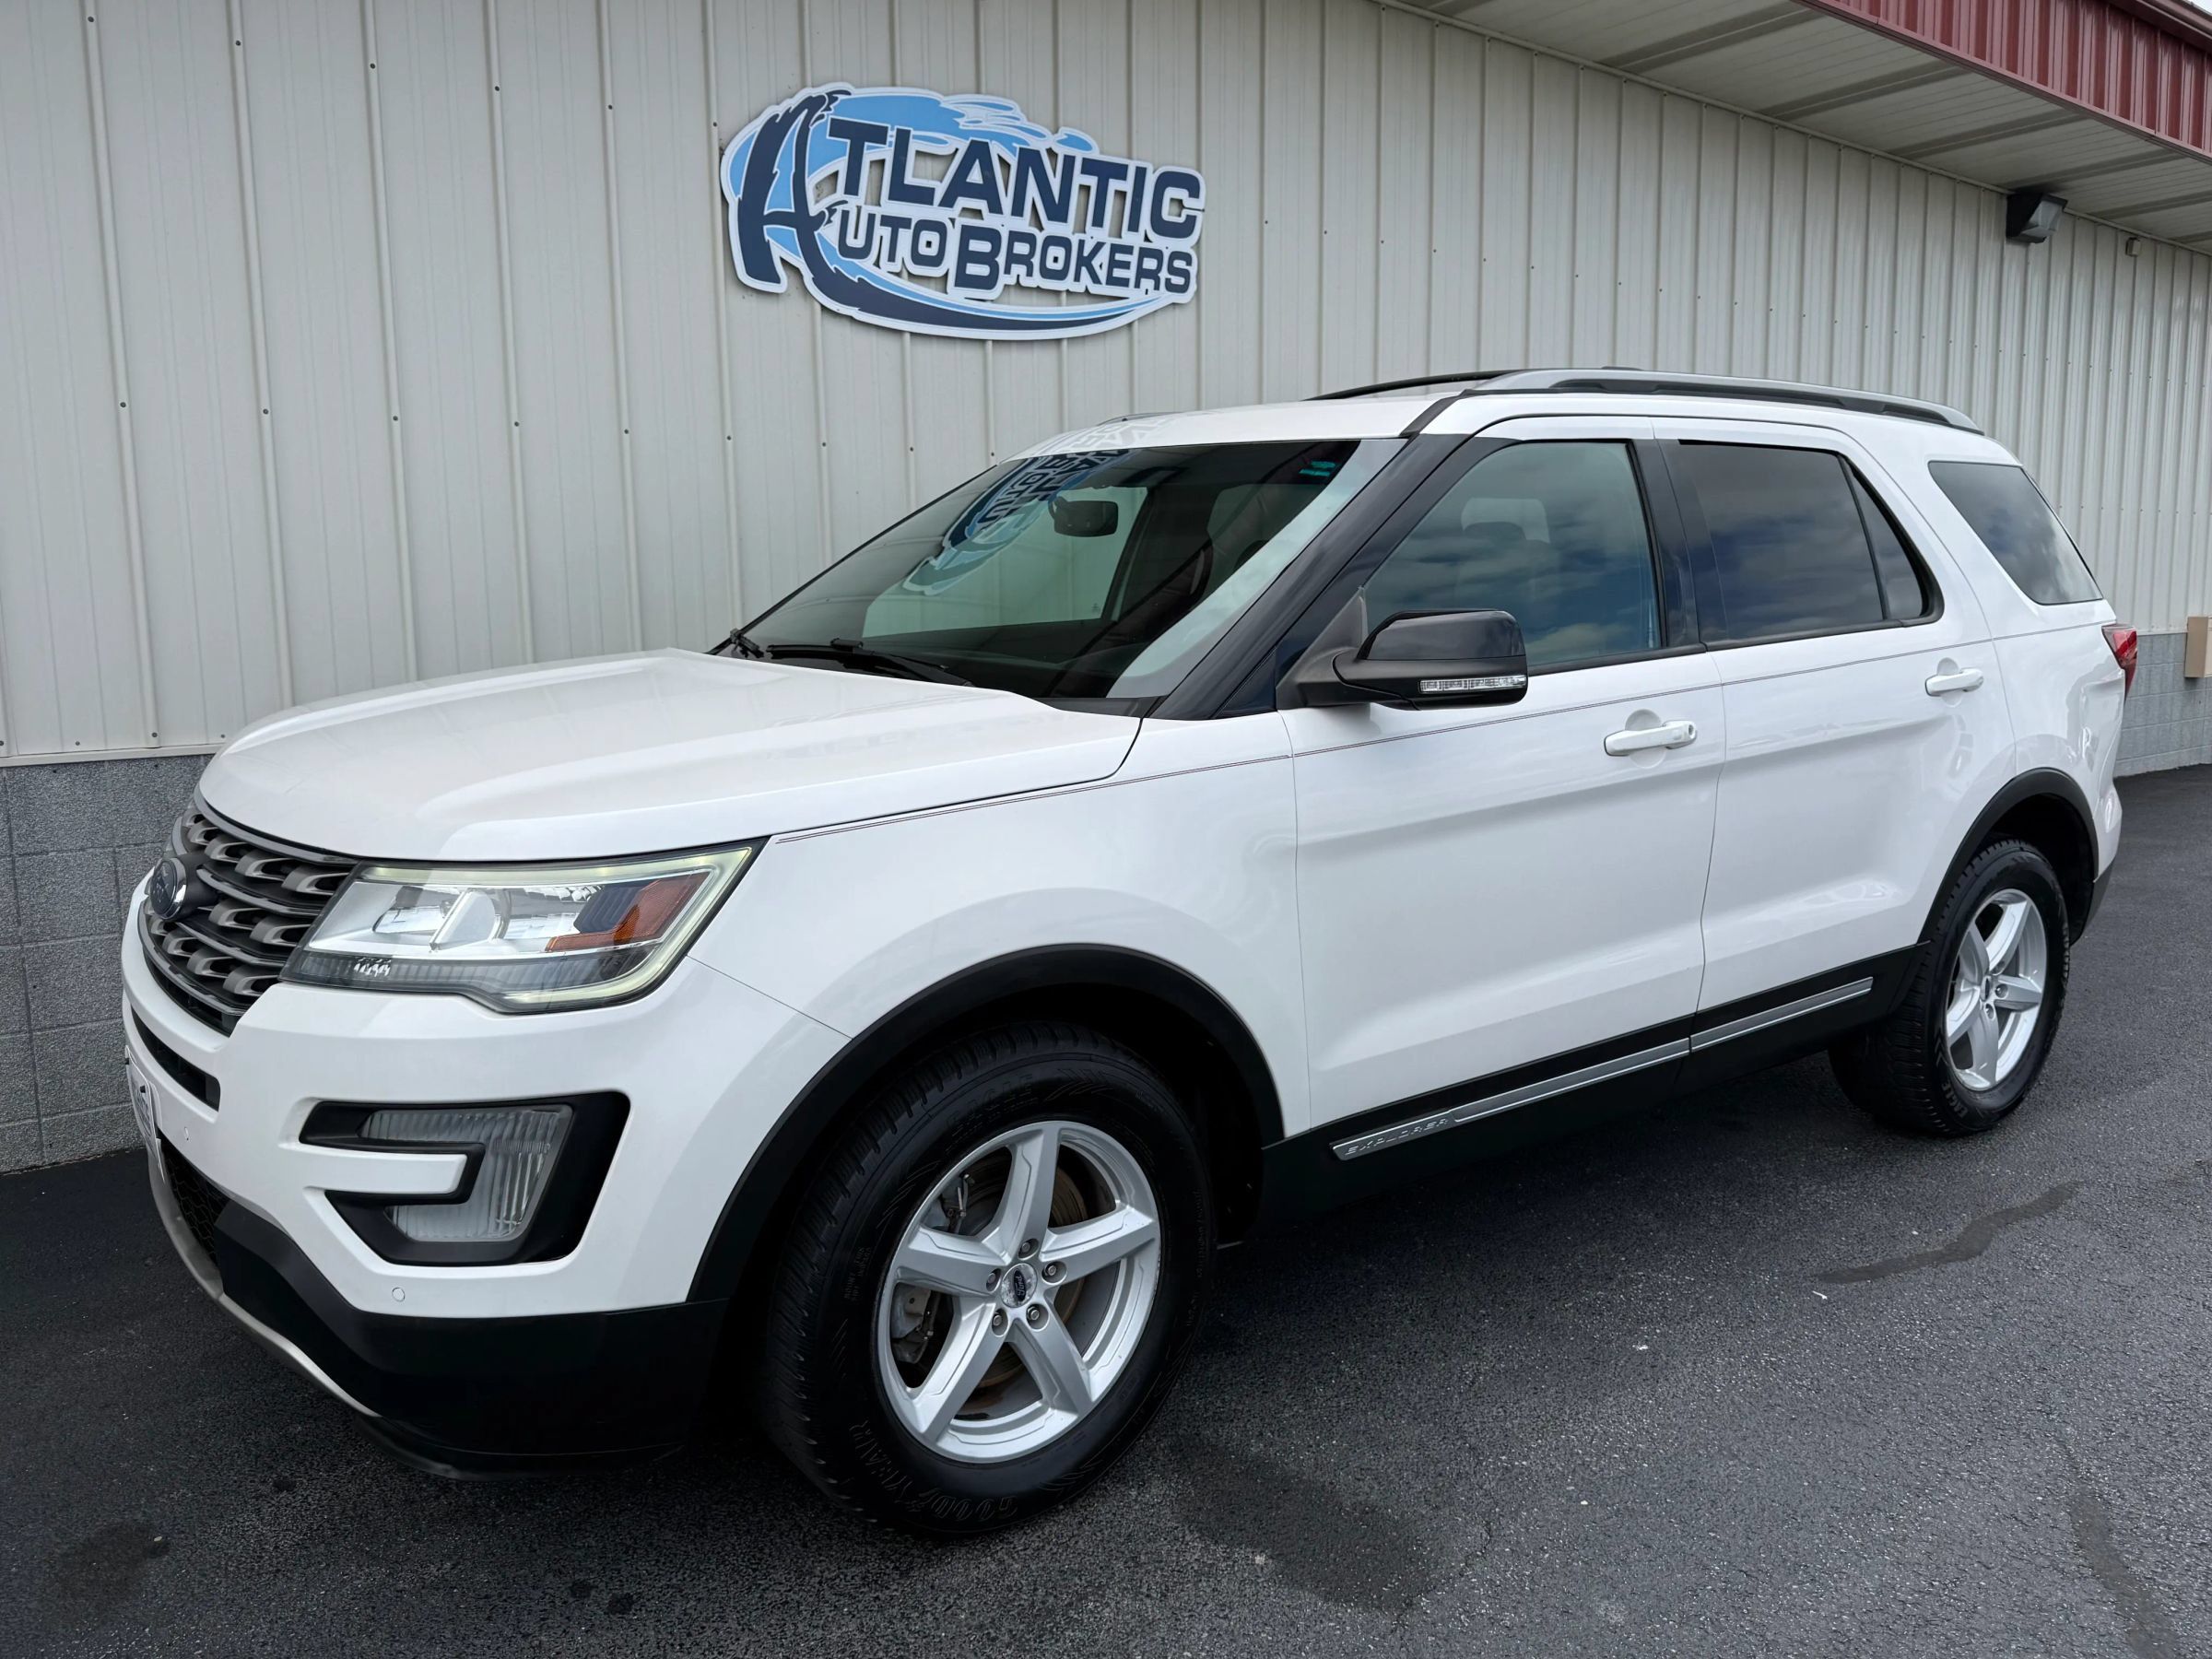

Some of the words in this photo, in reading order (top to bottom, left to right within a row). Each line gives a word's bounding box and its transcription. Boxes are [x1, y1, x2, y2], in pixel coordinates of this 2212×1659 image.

[737, 90, 1201, 284] ATLANTIC
[954, 223, 1193, 294] BROKERS
[1344, 1117, 1449, 1156] EXPLORER
